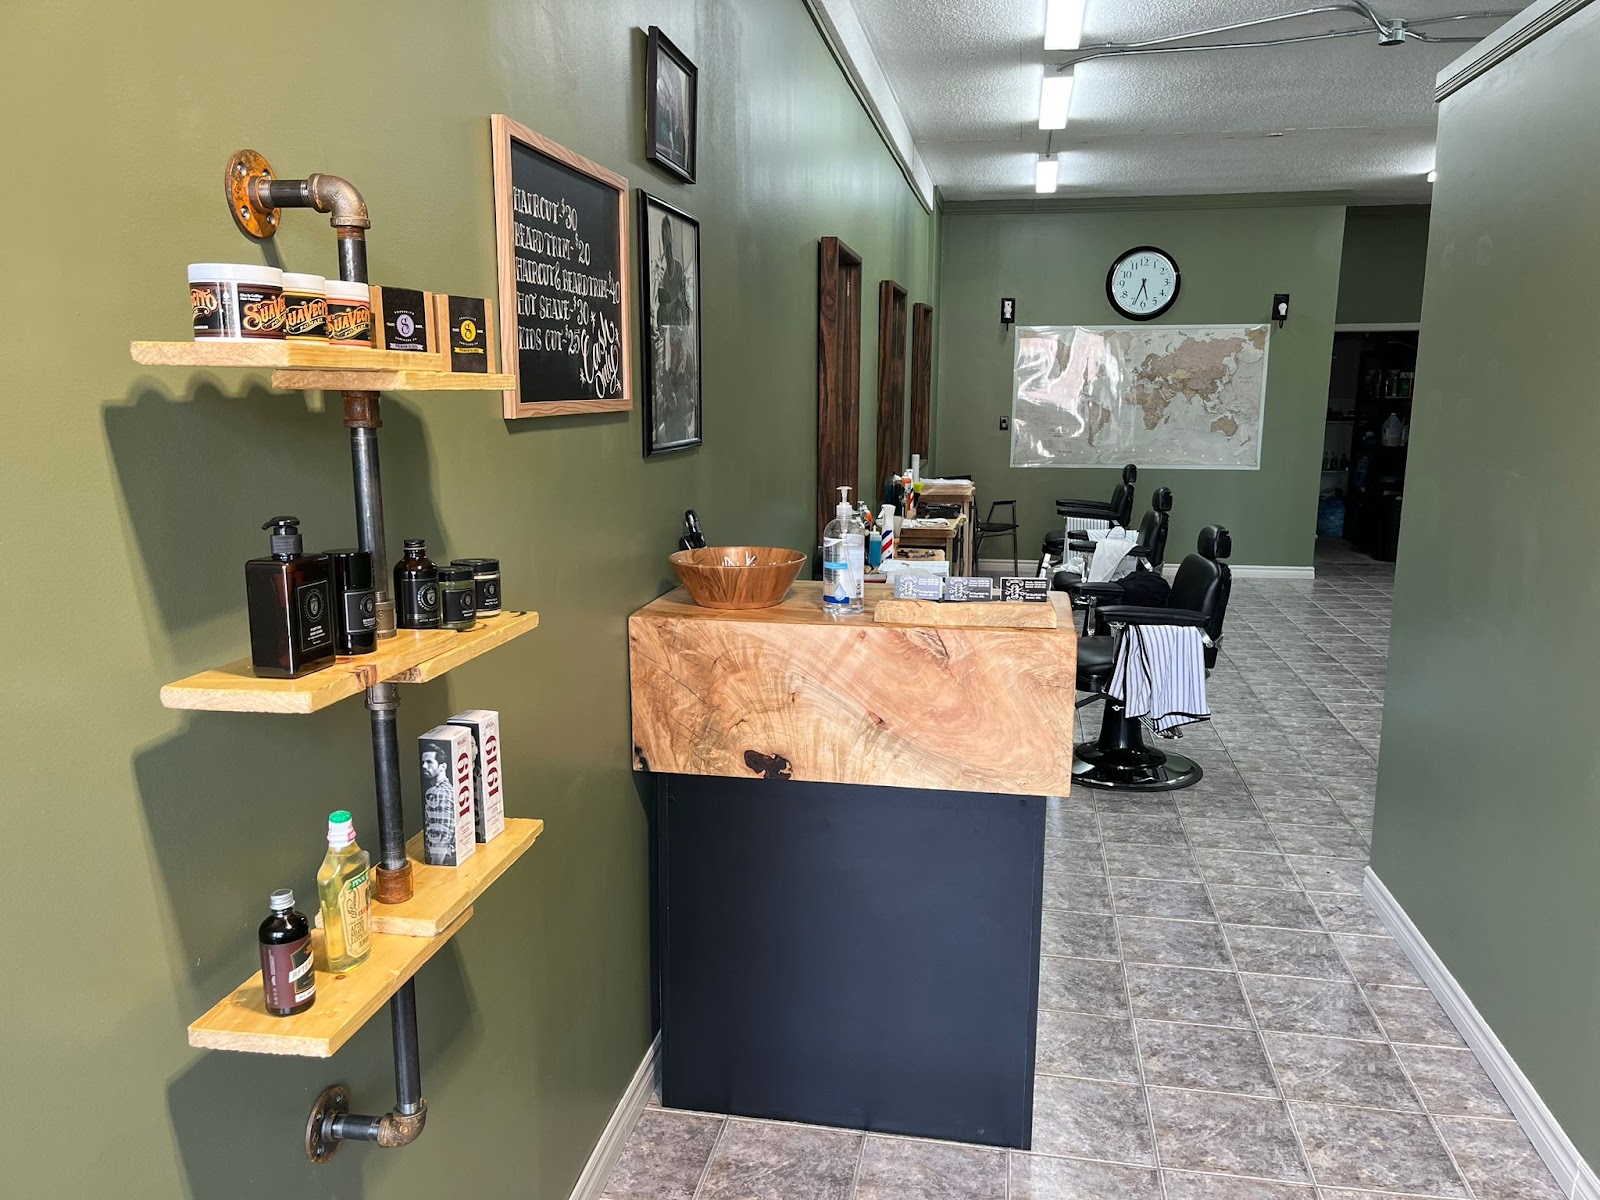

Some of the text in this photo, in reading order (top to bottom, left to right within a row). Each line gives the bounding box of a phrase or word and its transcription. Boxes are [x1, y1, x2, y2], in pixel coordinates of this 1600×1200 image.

[514, 221, 544, 253] BEARD
[515, 256, 554, 287] HAIRCUT
[562, 269, 588, 297] BEARD
[517, 292, 537, 316] HOT
[518, 326, 541, 351] KIDS
